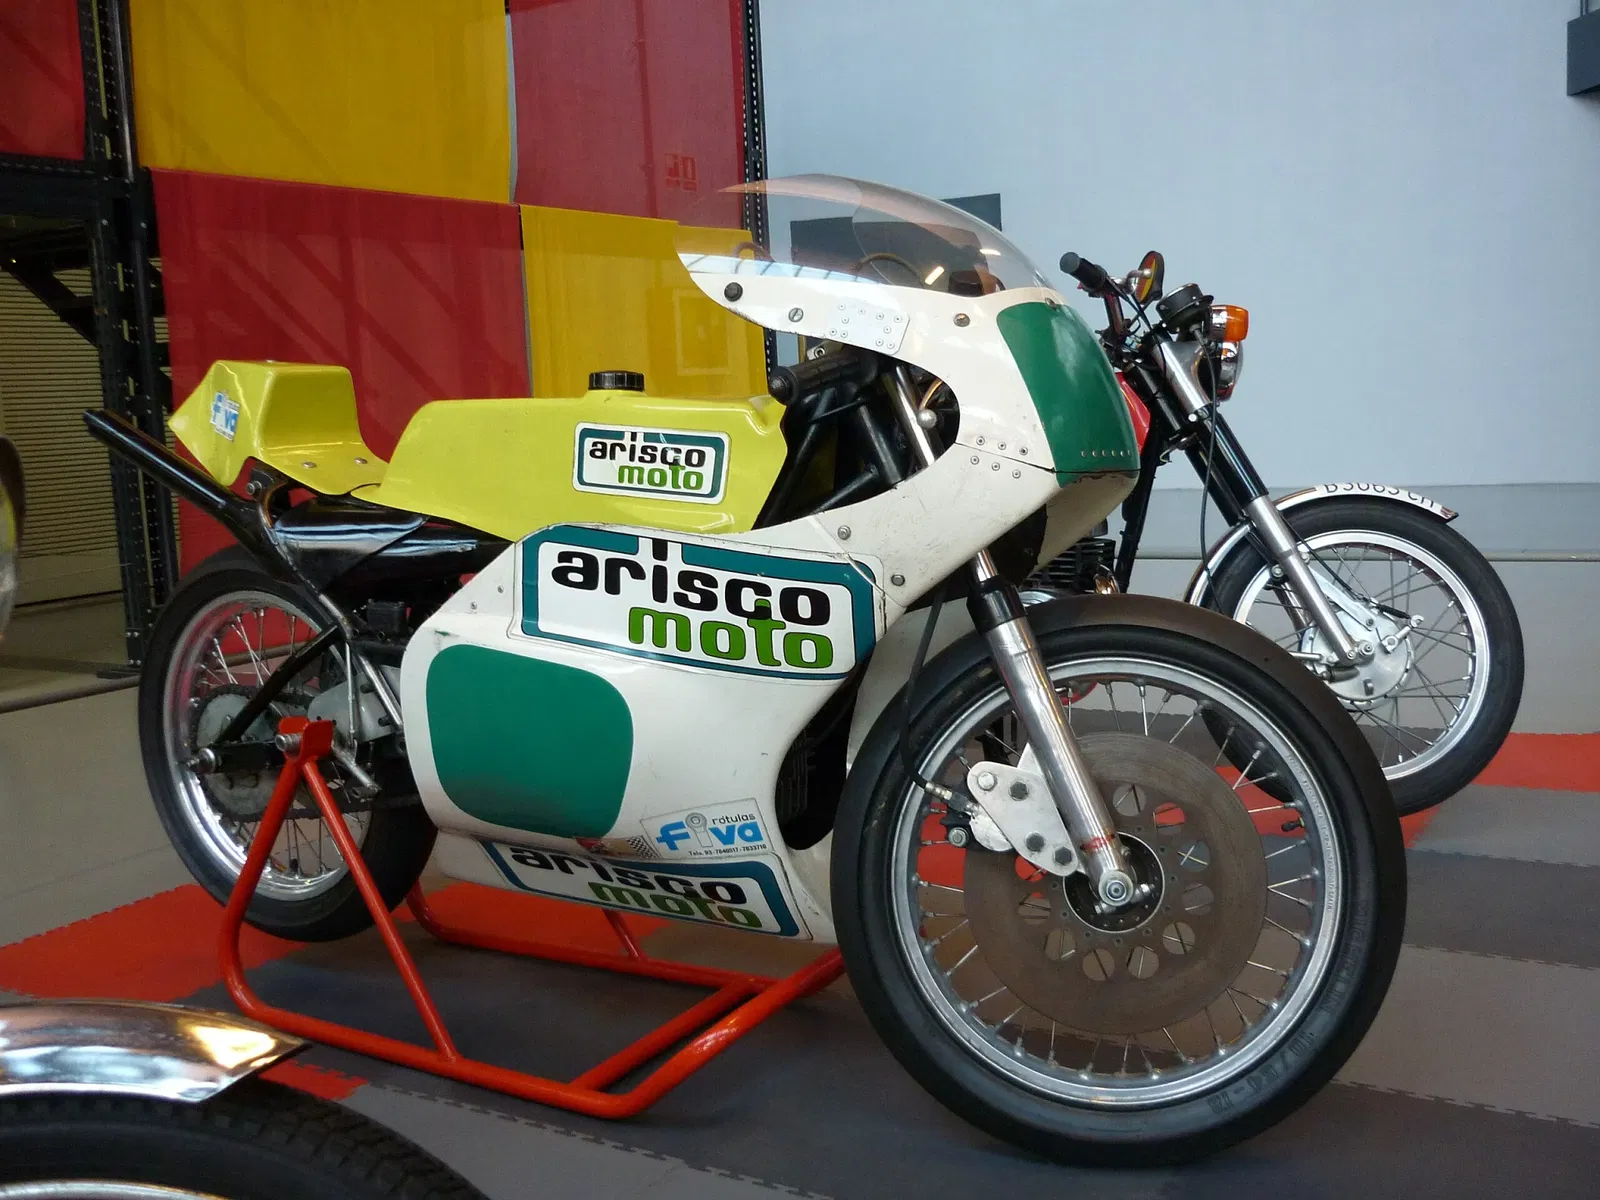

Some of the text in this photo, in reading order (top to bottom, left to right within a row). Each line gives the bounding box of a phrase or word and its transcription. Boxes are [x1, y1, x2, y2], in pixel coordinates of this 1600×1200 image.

[589, 432, 706, 468] arisco
[618, 456, 704, 491] moto
[551, 538, 831, 627] arisco
[628, 599, 834, 669] moto
[711, 812, 756, 826] rótulas
[509, 845, 748, 905] arisco
[588, 882, 763, 929] moto
